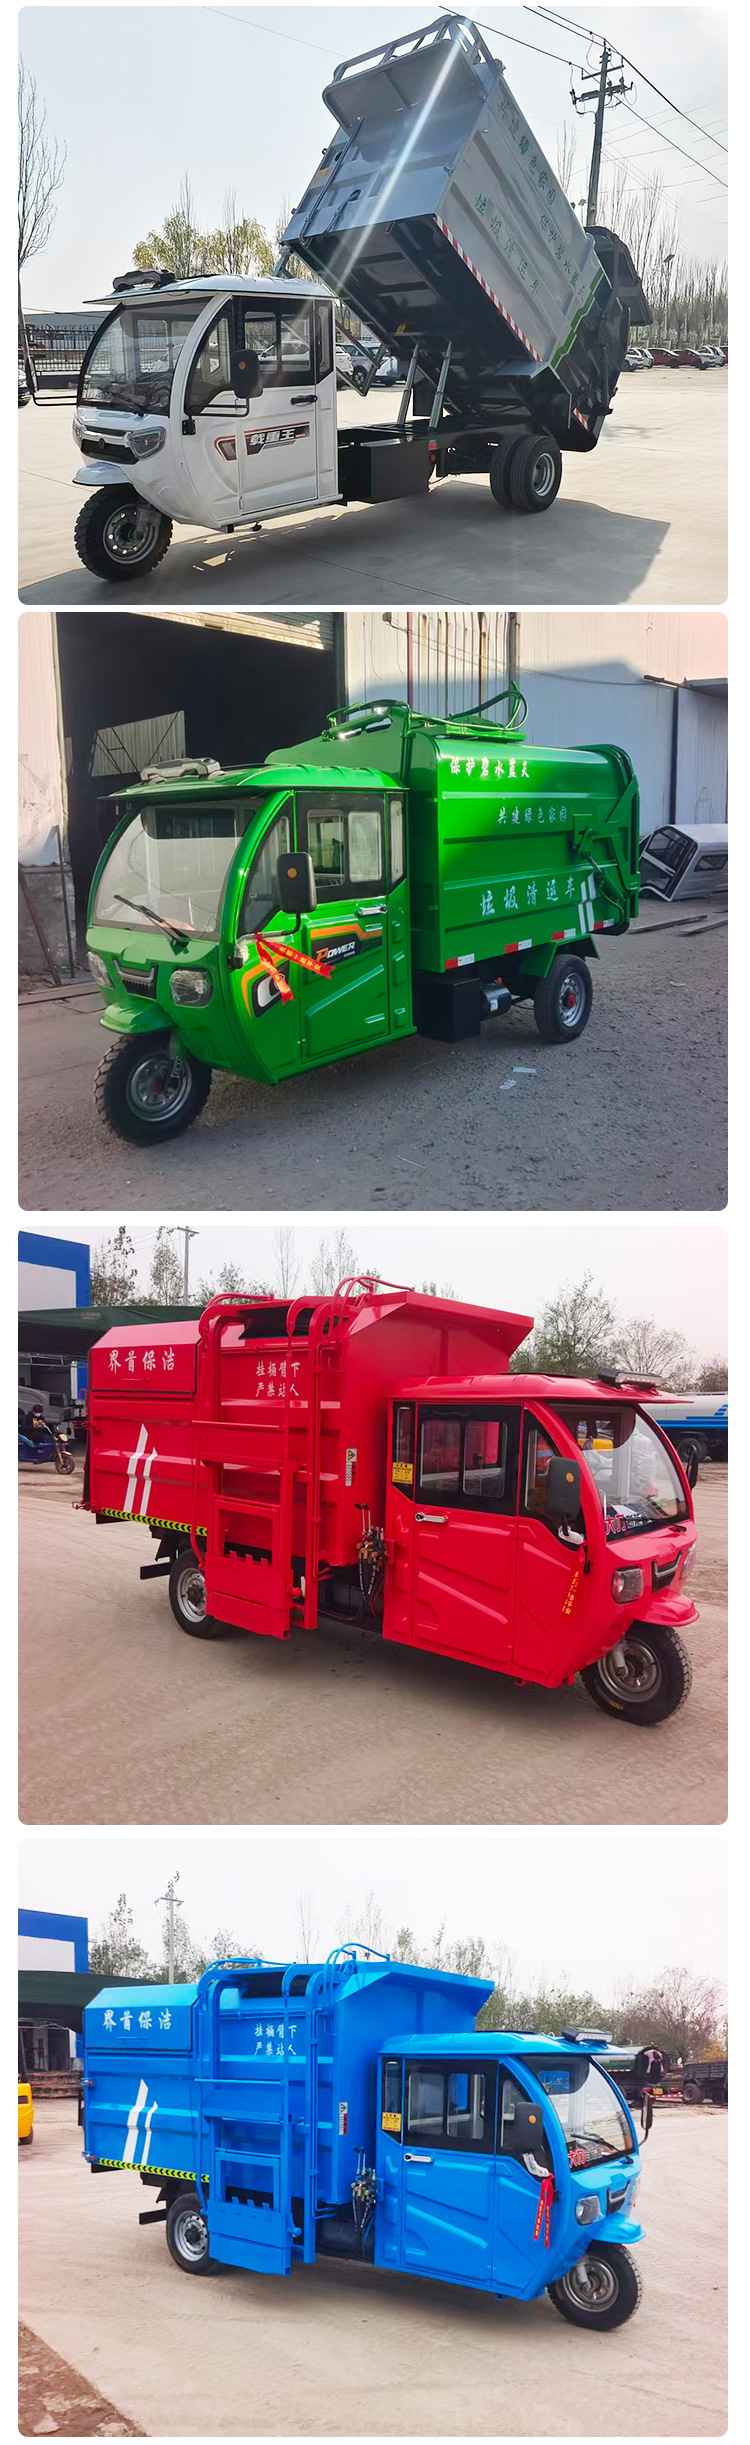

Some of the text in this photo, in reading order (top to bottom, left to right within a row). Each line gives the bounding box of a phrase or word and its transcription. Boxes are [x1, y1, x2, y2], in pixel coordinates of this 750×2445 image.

[450, 756, 530, 778] 保护碧水蓝天
[498, 805, 567, 824] 共建绿色家园
[480, 875, 575, 917] 垃圾清运车
[107, 1346, 176, 1375] 界首保洁
[255, 1360, 301, 1379] 挂桶臂下
[255, 1380, 300, 1398] 严禁站人
[102, 2007, 172, 2033] 界首保洁
[253, 2040, 297, 2057] 严禁站人
